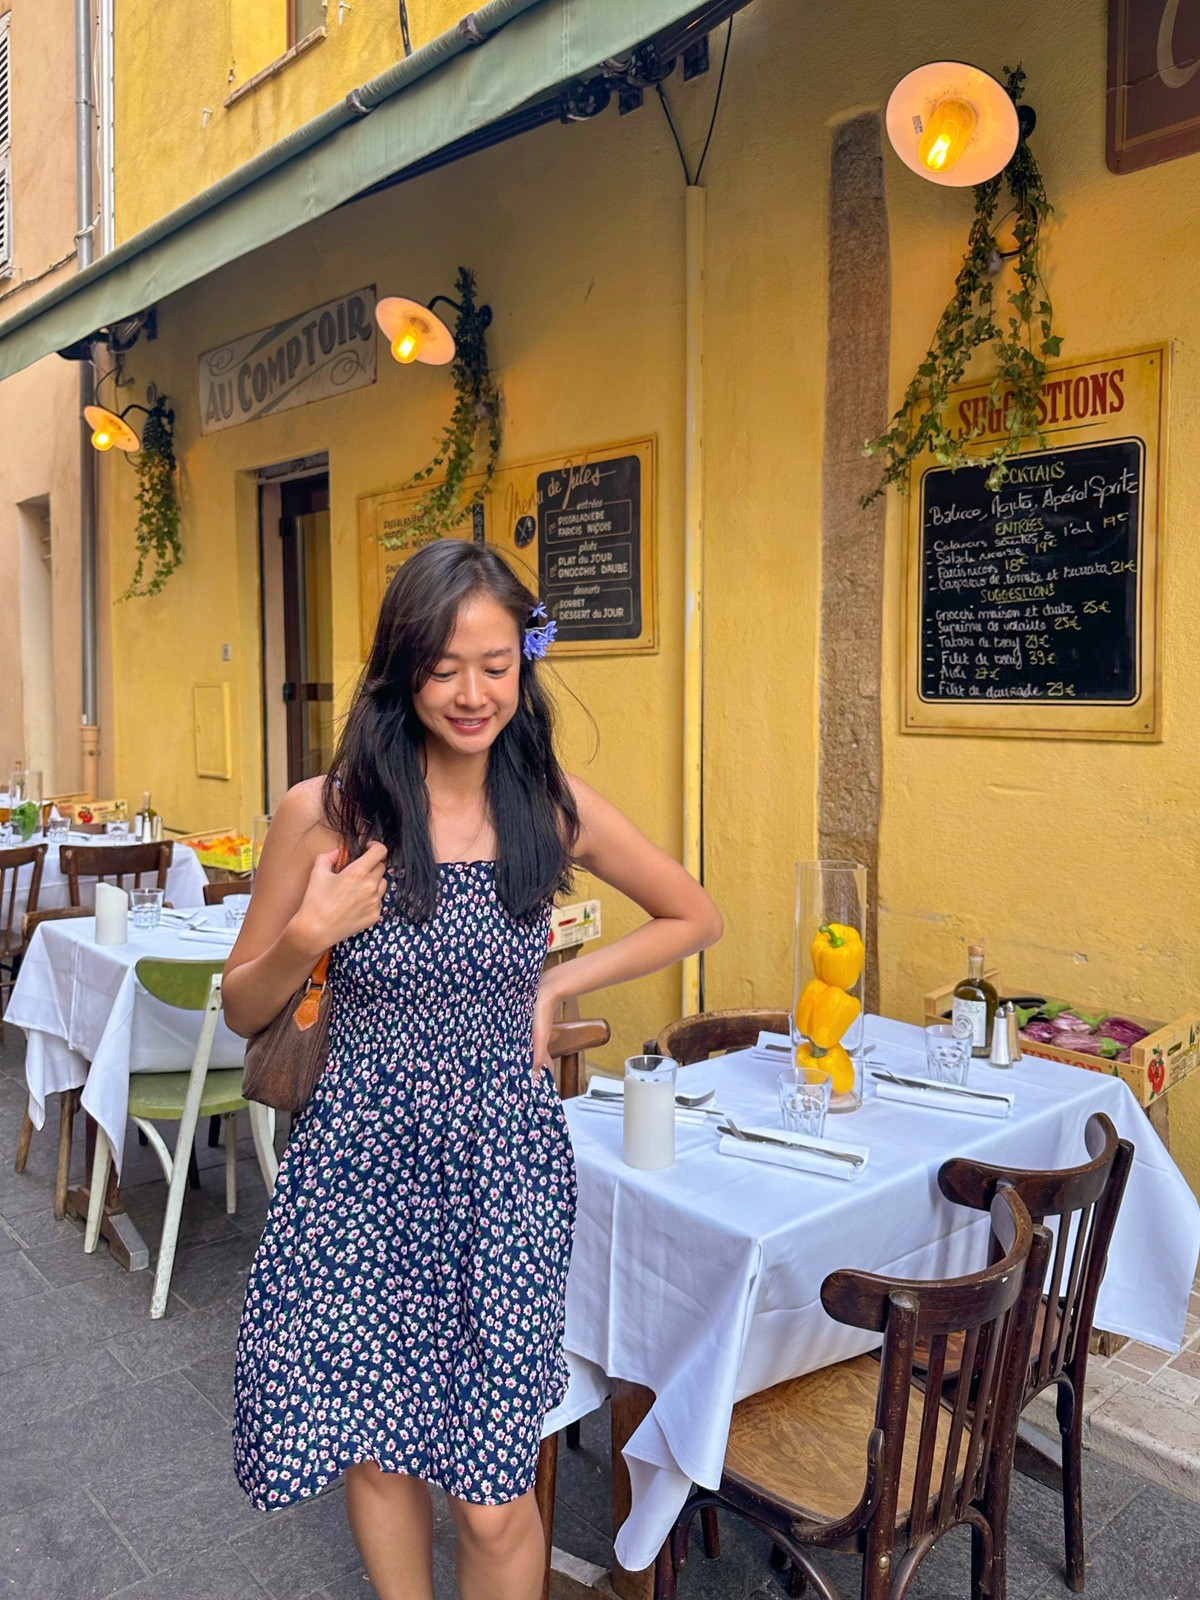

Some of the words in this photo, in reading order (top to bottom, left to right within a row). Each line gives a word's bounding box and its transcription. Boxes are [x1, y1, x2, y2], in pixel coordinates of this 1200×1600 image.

[205, 379, 233, 425] AU
[237, 296, 373, 413] COMPTOIR
[547, 476, 563, 497] de
[561, 450, 617, 510] Jules
